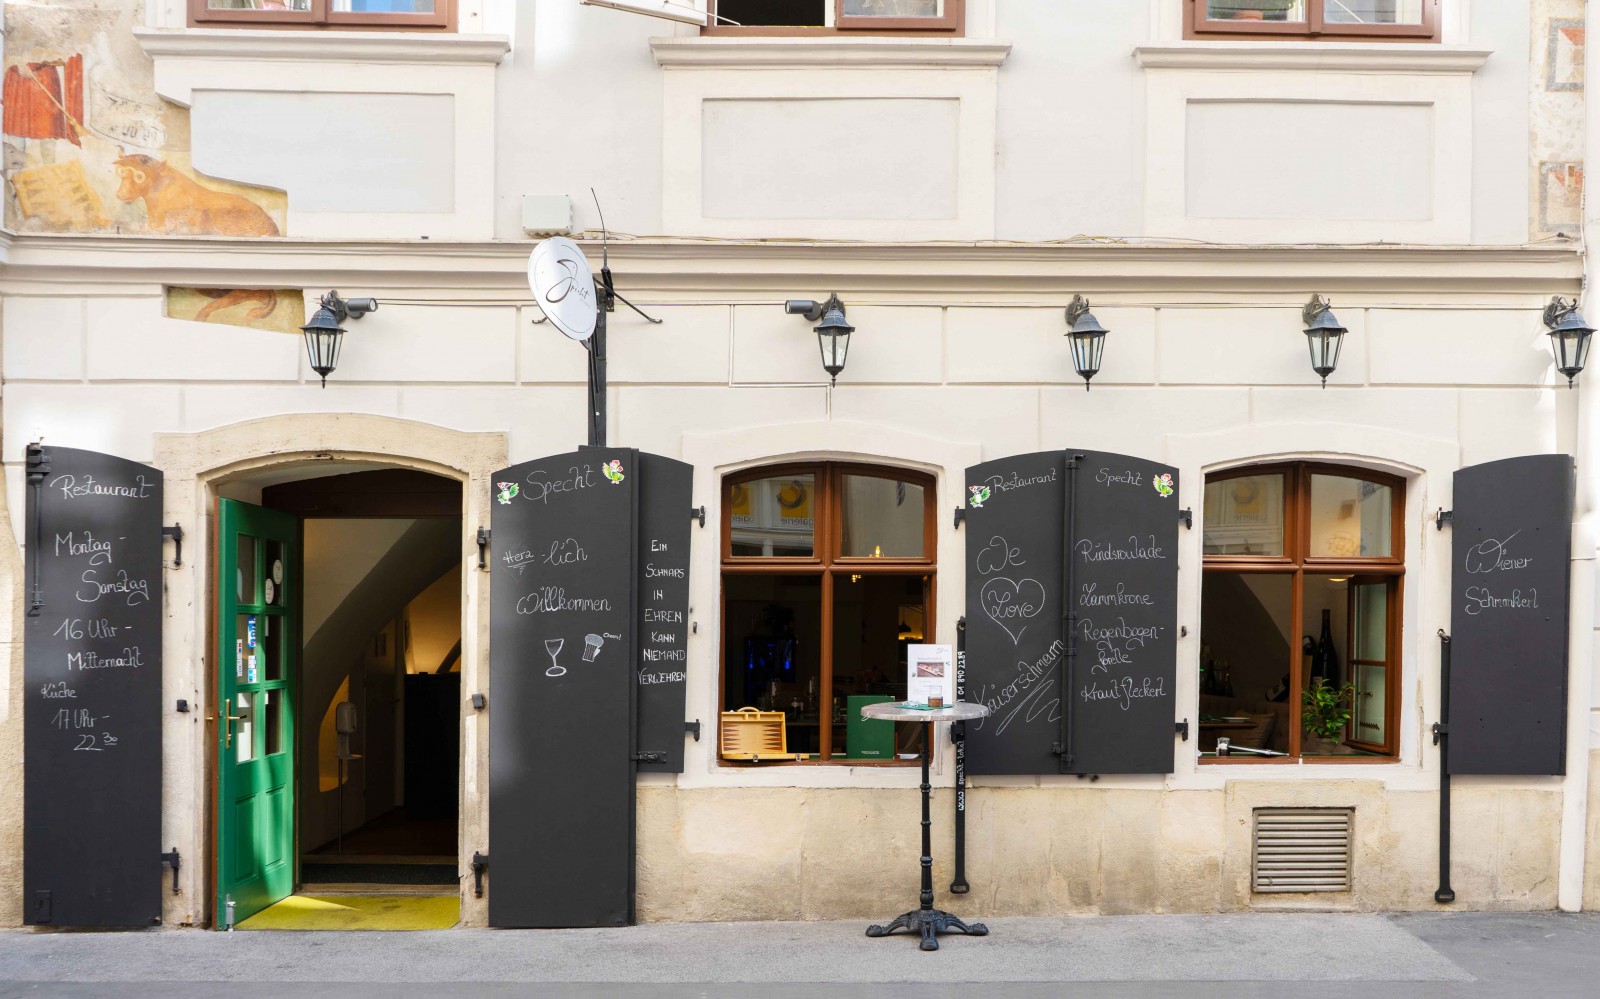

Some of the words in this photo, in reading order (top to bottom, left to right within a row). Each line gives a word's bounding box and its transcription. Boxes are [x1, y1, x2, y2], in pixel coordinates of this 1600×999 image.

[50, 474, 155, 499] Restaurant
[522, 464, 597, 504] Specht
[984, 468, 1057, 493] Restaurant
[1095, 468, 1143, 487] Specht
[55, 530, 112, 566] Montag
[503, 550, 535, 565] Herz
[976, 535, 1027, 575] We
[1074, 535, 1166, 563] Rindsroulade
[1465, 528, 1533, 574] Wiener
[75, 569, 149, 606] Samstag
[653, 590, 663, 600] IN
[1079, 582, 1155, 606] Lammkrone
[516, 586, 612, 615] Willkommen
[987, 590, 1034, 618] Love
[1464, 586, 1539, 615] Schmankerl
[644, 608, 682, 623] EHREN
[53, 618, 84, 640] 16
[88, 618, 118, 638] Uhr
[651, 631, 675, 643] KANN
[67, 646, 144, 671] Mitternacht
[643, 648, 686, 662] NIEMAND
[637, 667, 686, 685] VERWEHREN
[957, 670, 965, 683] 890
[41, 681, 78, 699] Küche
[51, 707, 70, 729] 17
[74, 708, 98, 729] Uhr
